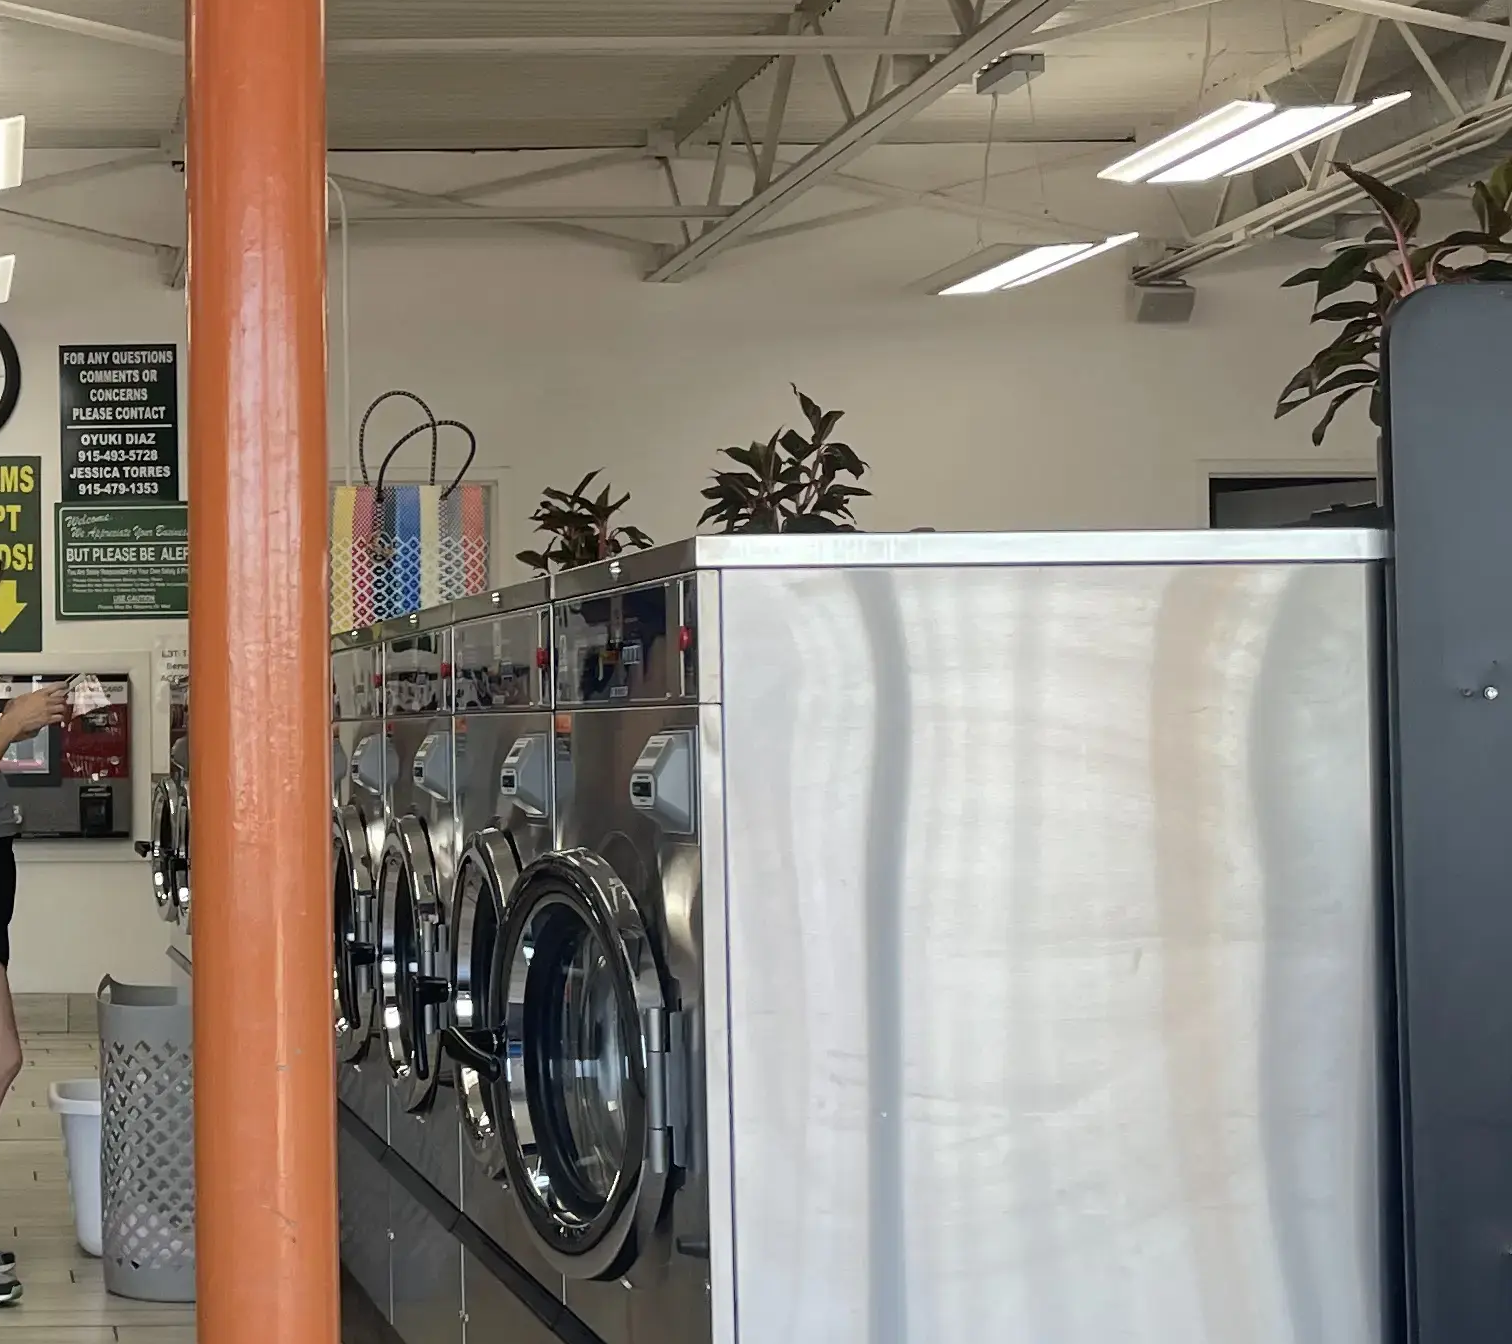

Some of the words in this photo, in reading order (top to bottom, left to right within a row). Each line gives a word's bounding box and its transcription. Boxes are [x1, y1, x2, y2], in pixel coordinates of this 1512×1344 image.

[63, 352, 85, 365] FOR
[87, 351, 110, 365] ANY
[112, 350, 173, 365] QUESTIONS
[79, 369, 140, 384] COMMENTS
[142, 369, 158, 383] OR
[89, 388, 148, 402] CONCERNS
[72, 407, 113, 421] PLEASE
[115, 406, 166, 420] CONTACT
[80, 433, 122, 446] OYUKI
[125, 432, 156, 445] DIAZ
[78, 449, 158, 462] 915-493-5728
[69, 466, 120, 479] JESSICA
[122, 465, 171, 478] TORRES
[78, 482, 159, 495] 915-479-1353
[66, 547, 90, 562] BUT
[92, 547, 137, 562] PLEASE
[139, 547, 156, 561] BE
